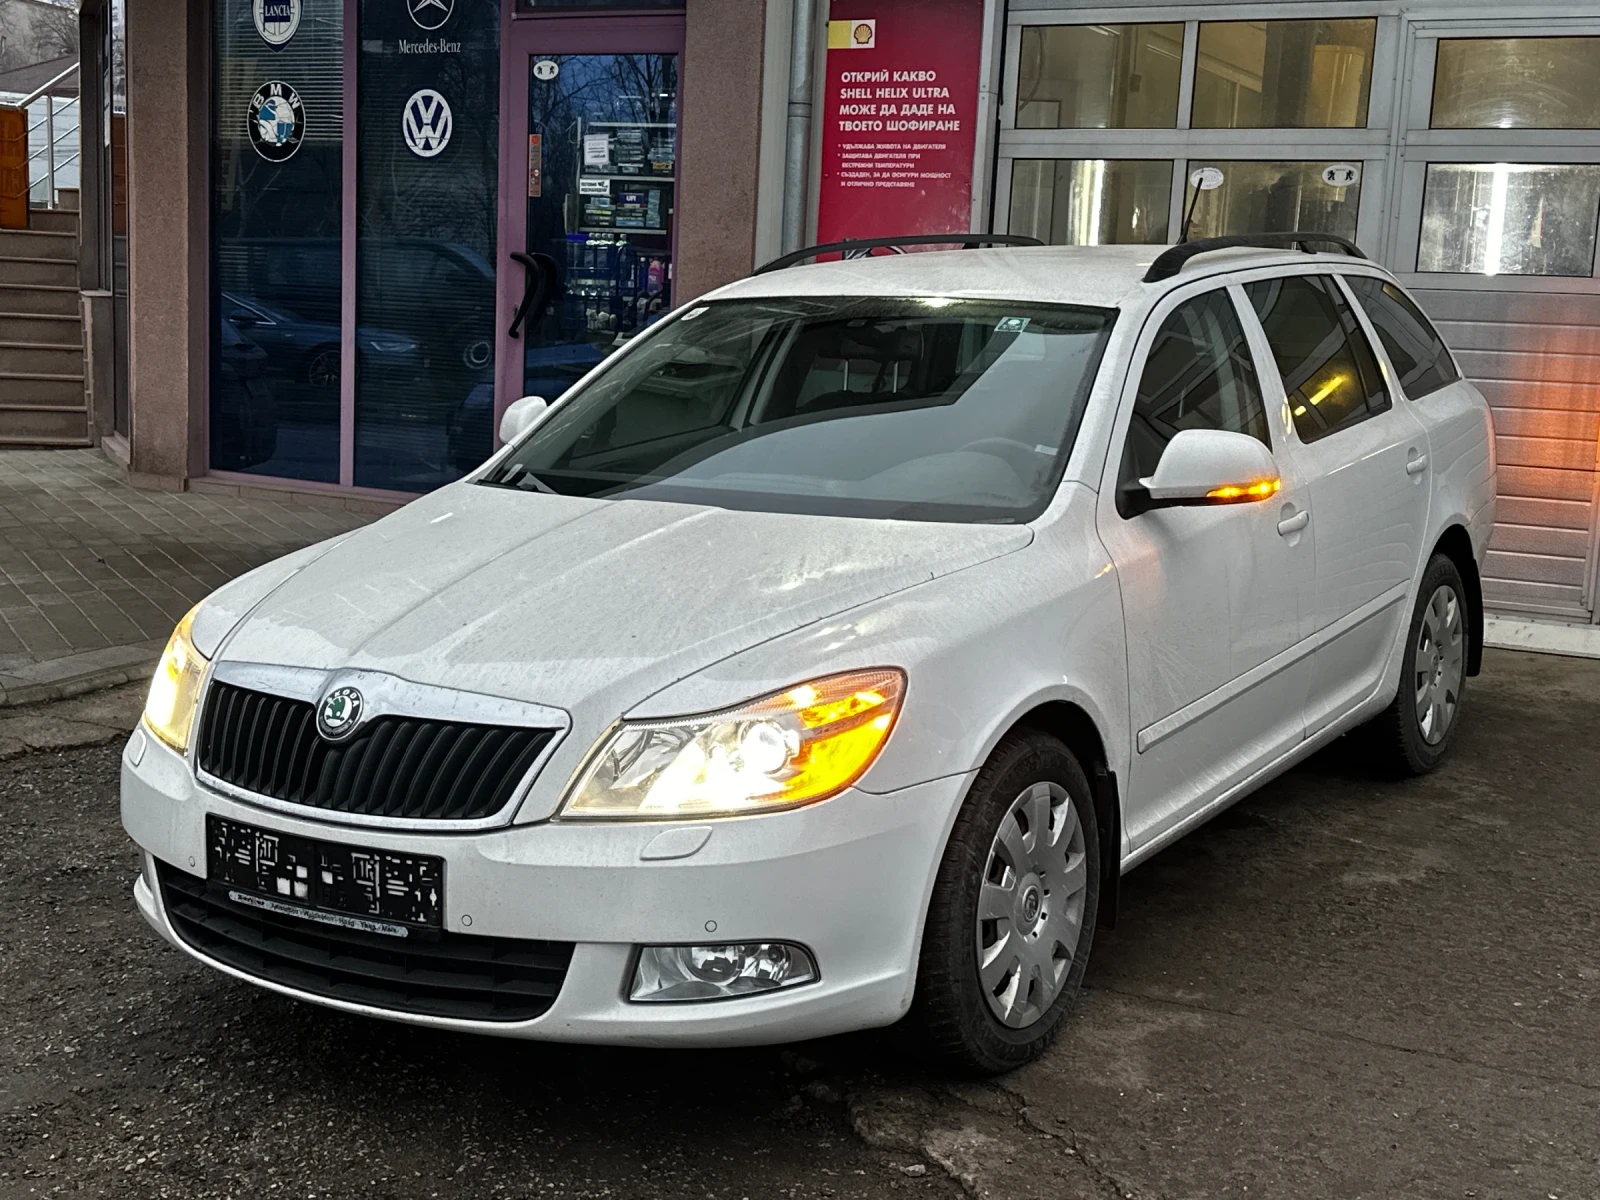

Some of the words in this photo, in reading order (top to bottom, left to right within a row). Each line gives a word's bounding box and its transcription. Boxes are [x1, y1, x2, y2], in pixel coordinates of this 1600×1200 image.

[264, 5, 291, 17] LANCIA
[398, 38, 461, 54] Mercedes-Benz
[841, 69, 889, 83] ОТКРИЙ
[893, 70, 937, 82] КАКВО
[252, 83, 301, 110] BMW
[840, 88, 872, 99] SHELL
[875, 87, 909, 99] HELIX
[912, 87, 950, 98] ULTRA
[839, 104, 876, 115] МОЖЕ
[879, 104, 897, 116] ДА
[900, 104, 934, 116] ДАДЕ
[938, 104, 956, 114] НА
[838, 120, 883, 131] ТВОЕТО
[886, 120, 960, 131] ШОФИРАНЕ
